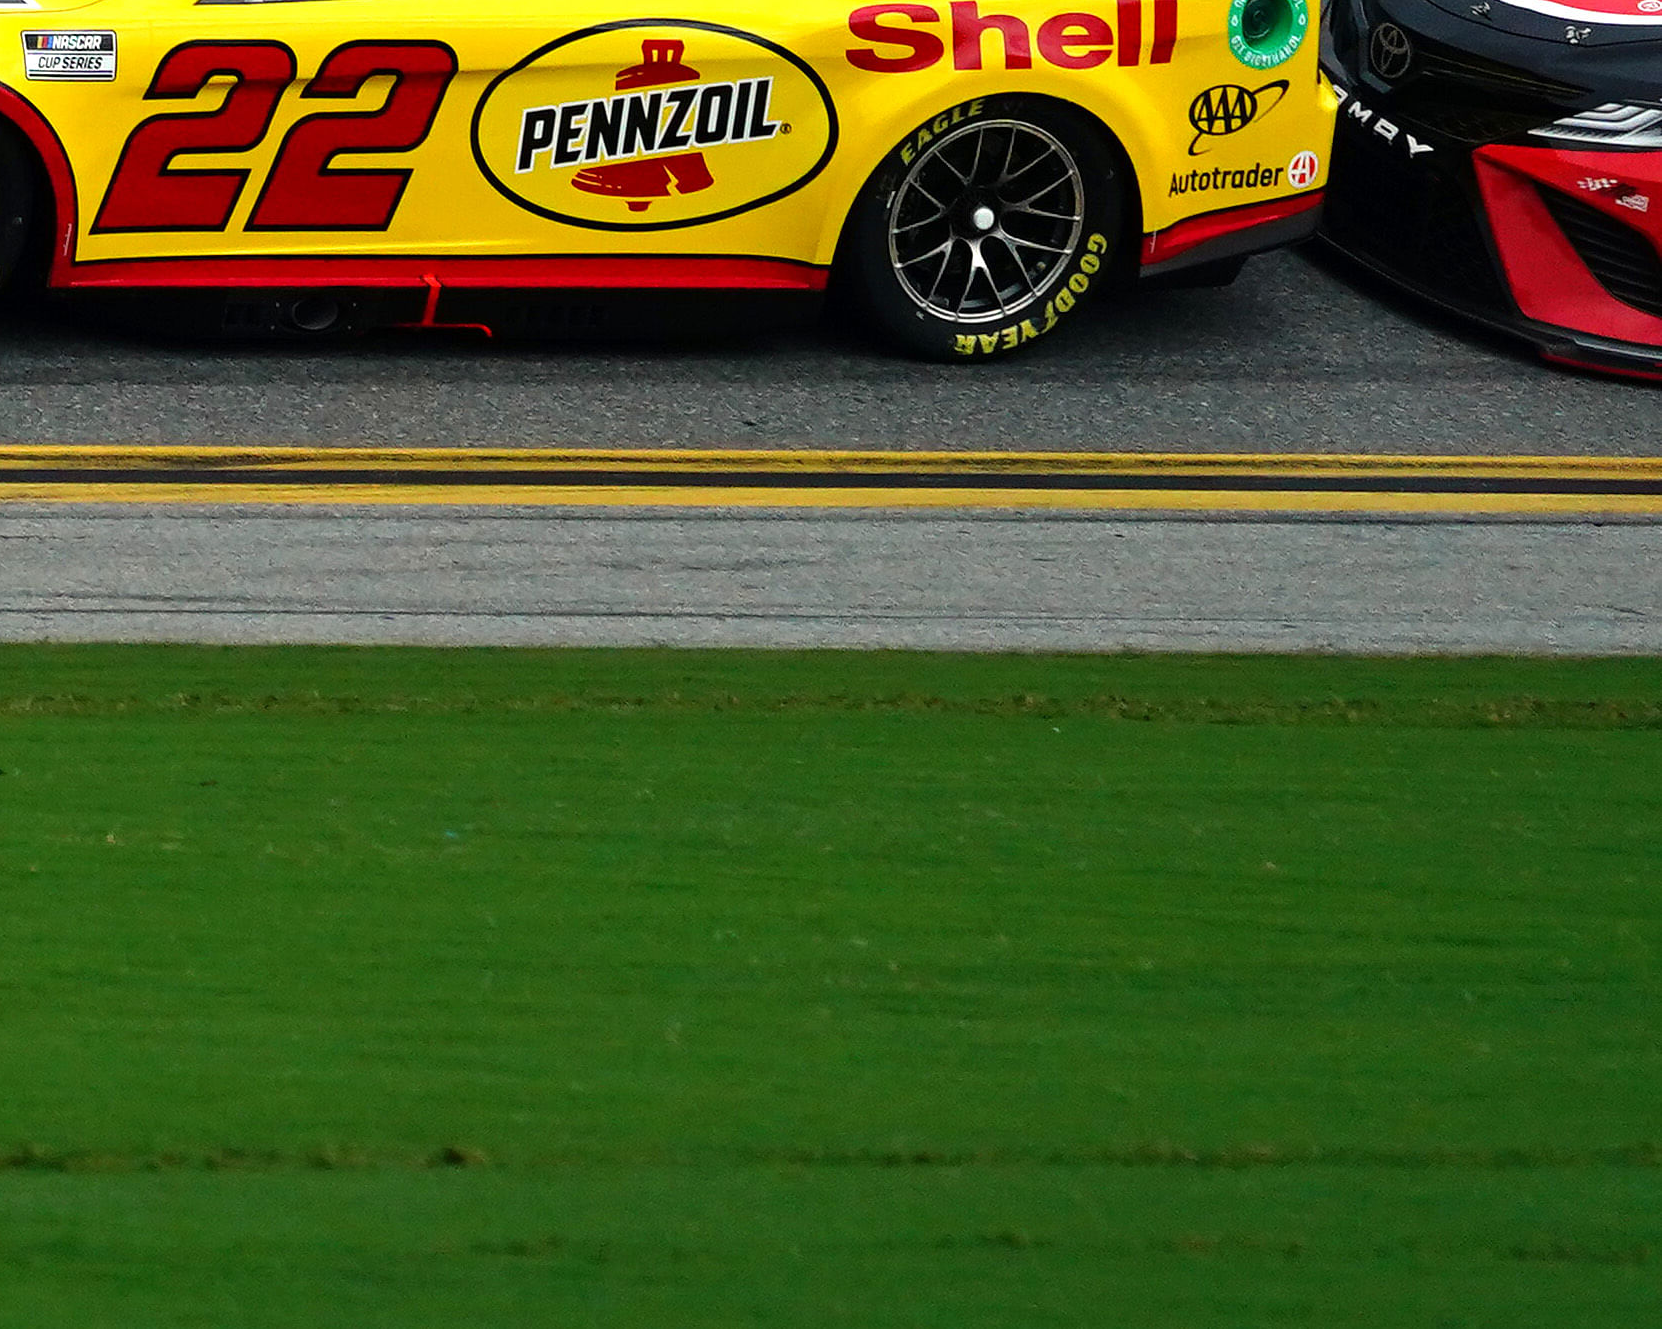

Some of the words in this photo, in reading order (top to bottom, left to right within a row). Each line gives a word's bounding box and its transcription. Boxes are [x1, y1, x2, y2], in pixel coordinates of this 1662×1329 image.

[38, 56, 62, 69] CUP
[62, 55, 103, 69] SERIES
[51, 34, 102, 50] NASCAR
[87, 37, 460, 236] 22
[516, 76, 782, 174] PENNZOIL
[899, 98, 986, 167] EAGLE
[1195, 86, 1250, 134] AAA
[1168, 162, 1285, 198] Autotrader
[953, 232, 1109, 356] GOODYEAR
